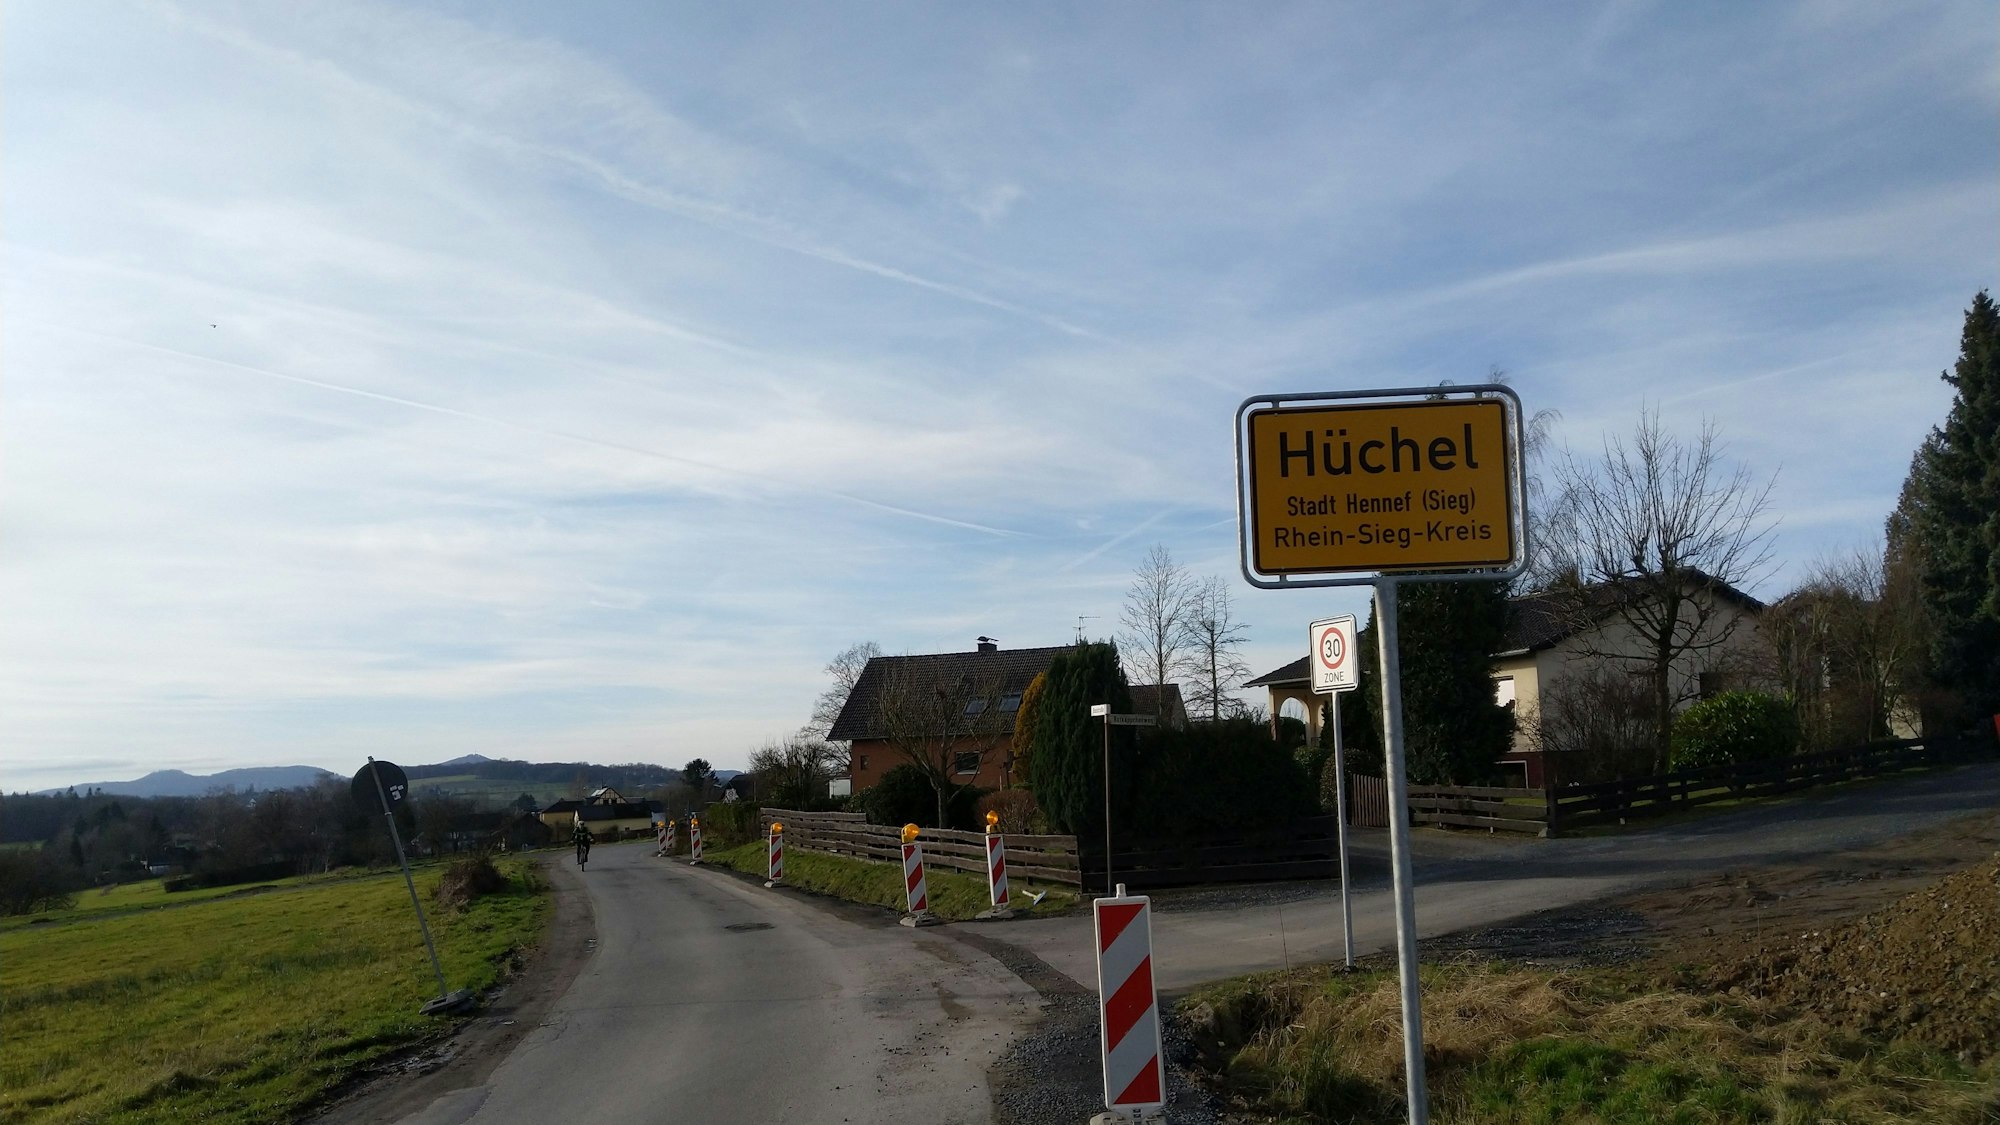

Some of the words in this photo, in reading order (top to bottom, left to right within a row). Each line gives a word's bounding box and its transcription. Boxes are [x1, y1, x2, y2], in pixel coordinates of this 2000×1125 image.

[1279, 423, 1479, 478] Hüchel
[1287, 495, 1337, 516] Stadt
[1347, 491, 1412, 514] Hennef
[1422, 487, 1476, 515] (Sieg)
[1274, 519, 1492, 549] Rhein-Sieg-Kreis
[1325, 638, 1340, 658] 30
[1324, 671, 1344, 682] ZONE
